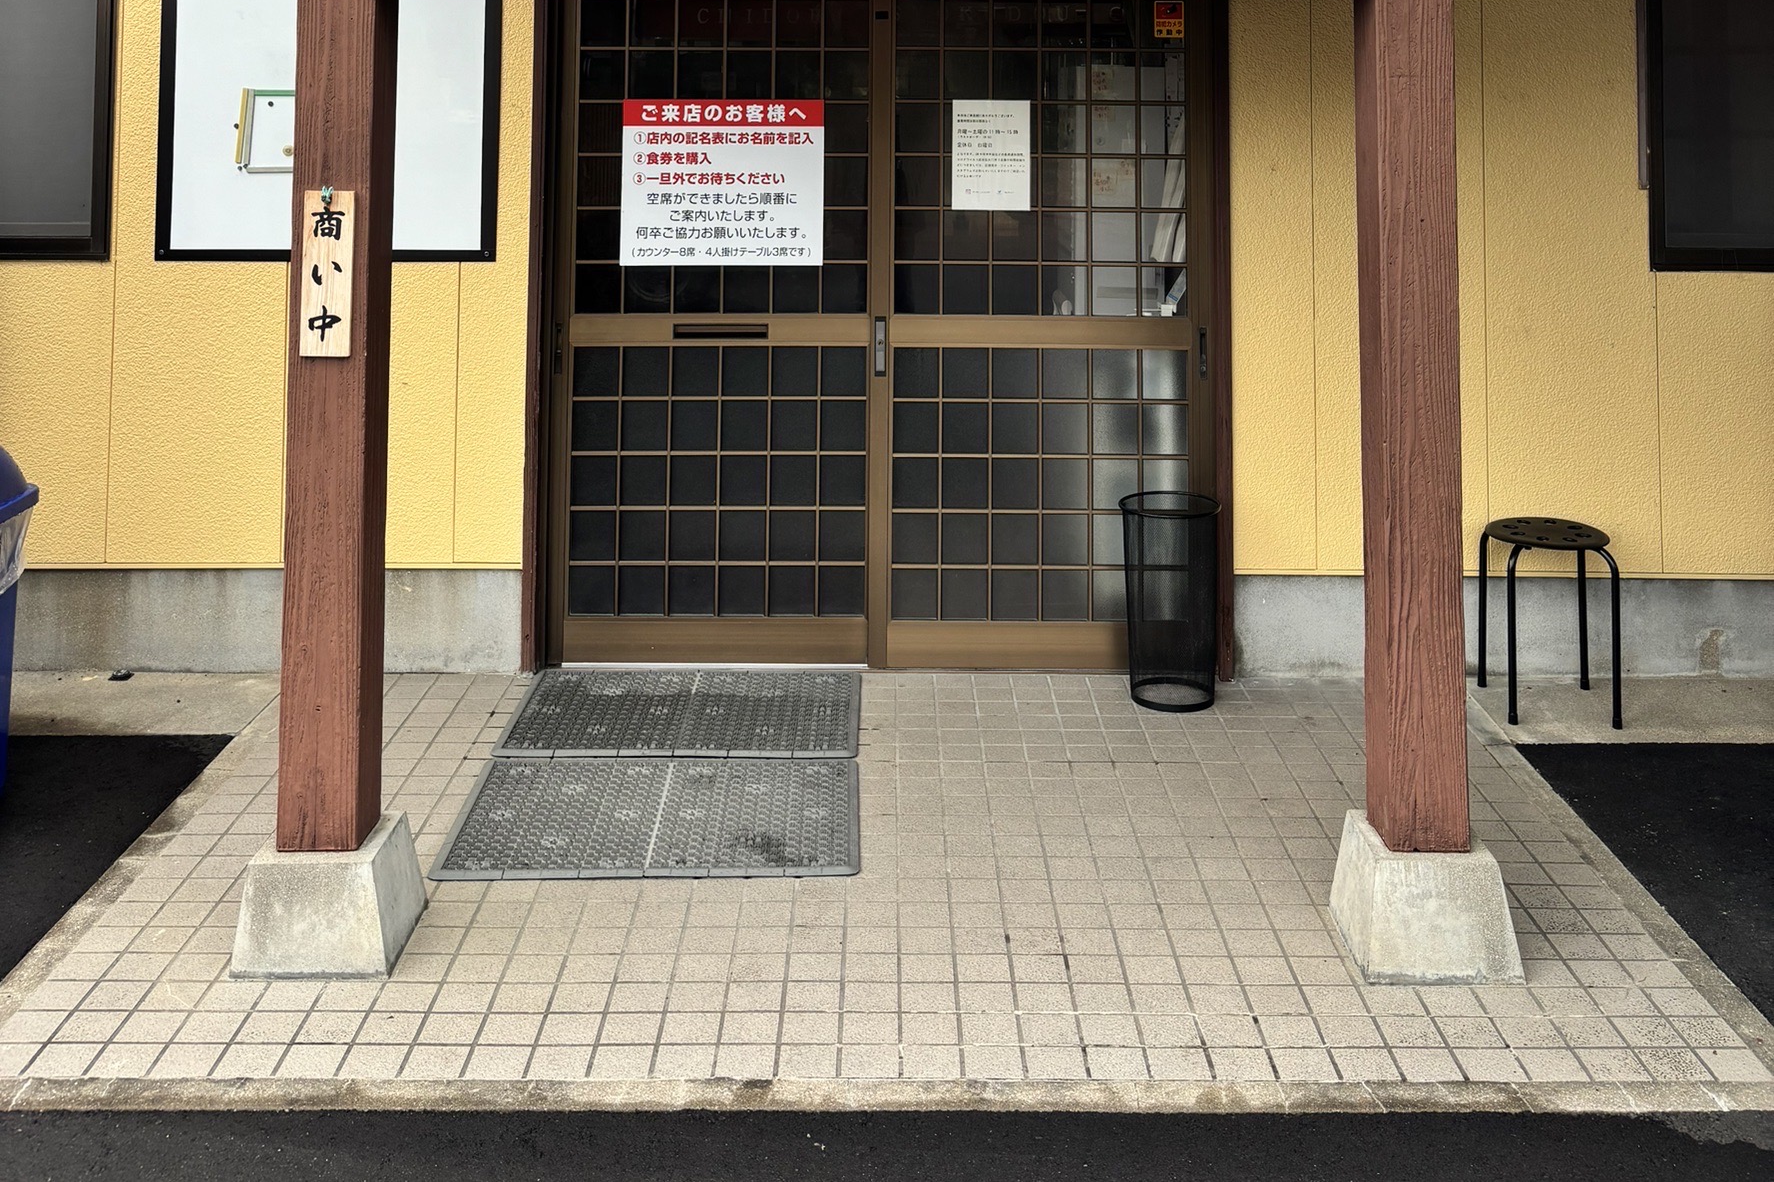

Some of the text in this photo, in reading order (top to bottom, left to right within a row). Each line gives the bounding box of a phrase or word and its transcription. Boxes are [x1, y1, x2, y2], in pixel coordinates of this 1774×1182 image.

[641, 104, 807, 123] ご来店のお客様へ
[633, 131, 814, 146] ①店内の記名表にお名前を記入
[633, 151, 712, 166] ②食券を購入
[632, 171, 785, 186] ③一旦外でお待ちください
[646, 192, 798, 205] 空席ができましたら順番に
[669, 209, 776, 223] ご案内いたします。
[636, 226, 808, 240] 何卒ご協力お願いいたします。
[308, 205, 345, 343] 商い中
